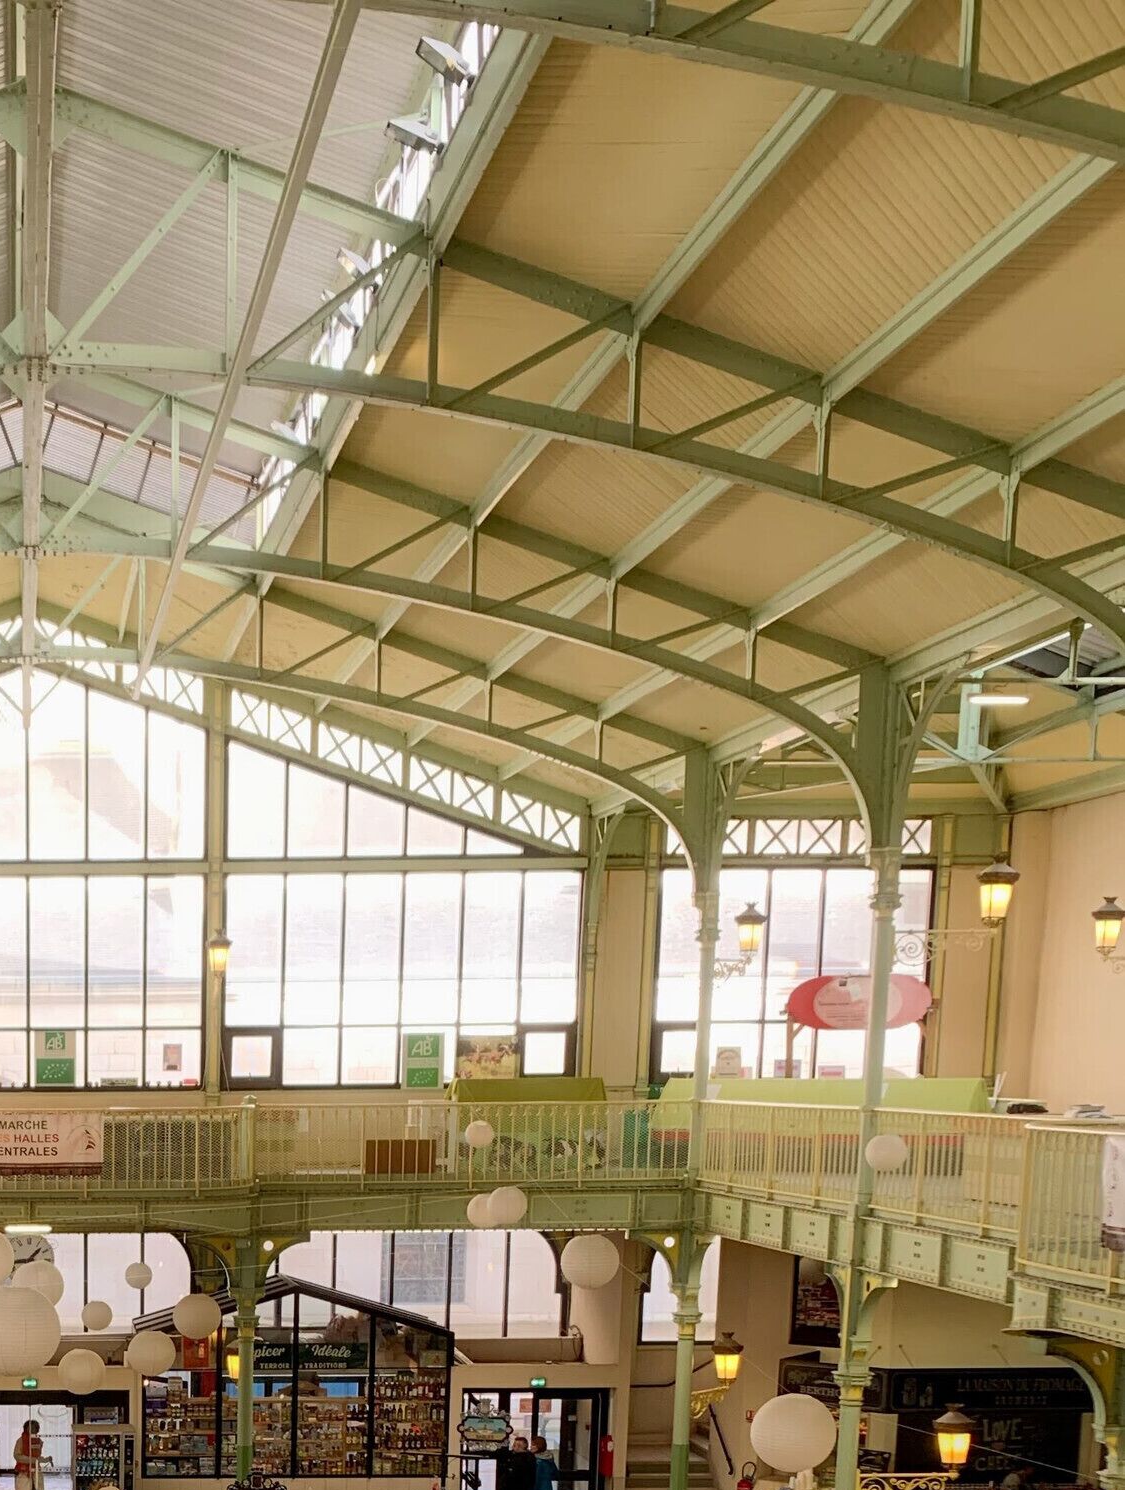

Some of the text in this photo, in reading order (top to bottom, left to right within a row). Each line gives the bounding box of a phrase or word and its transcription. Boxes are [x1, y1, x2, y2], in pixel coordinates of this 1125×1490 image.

[411, 1040, 433, 1056] AB
[13, 1133, 60, 1144] HALLES
[254, 1344, 286, 1359] picer
